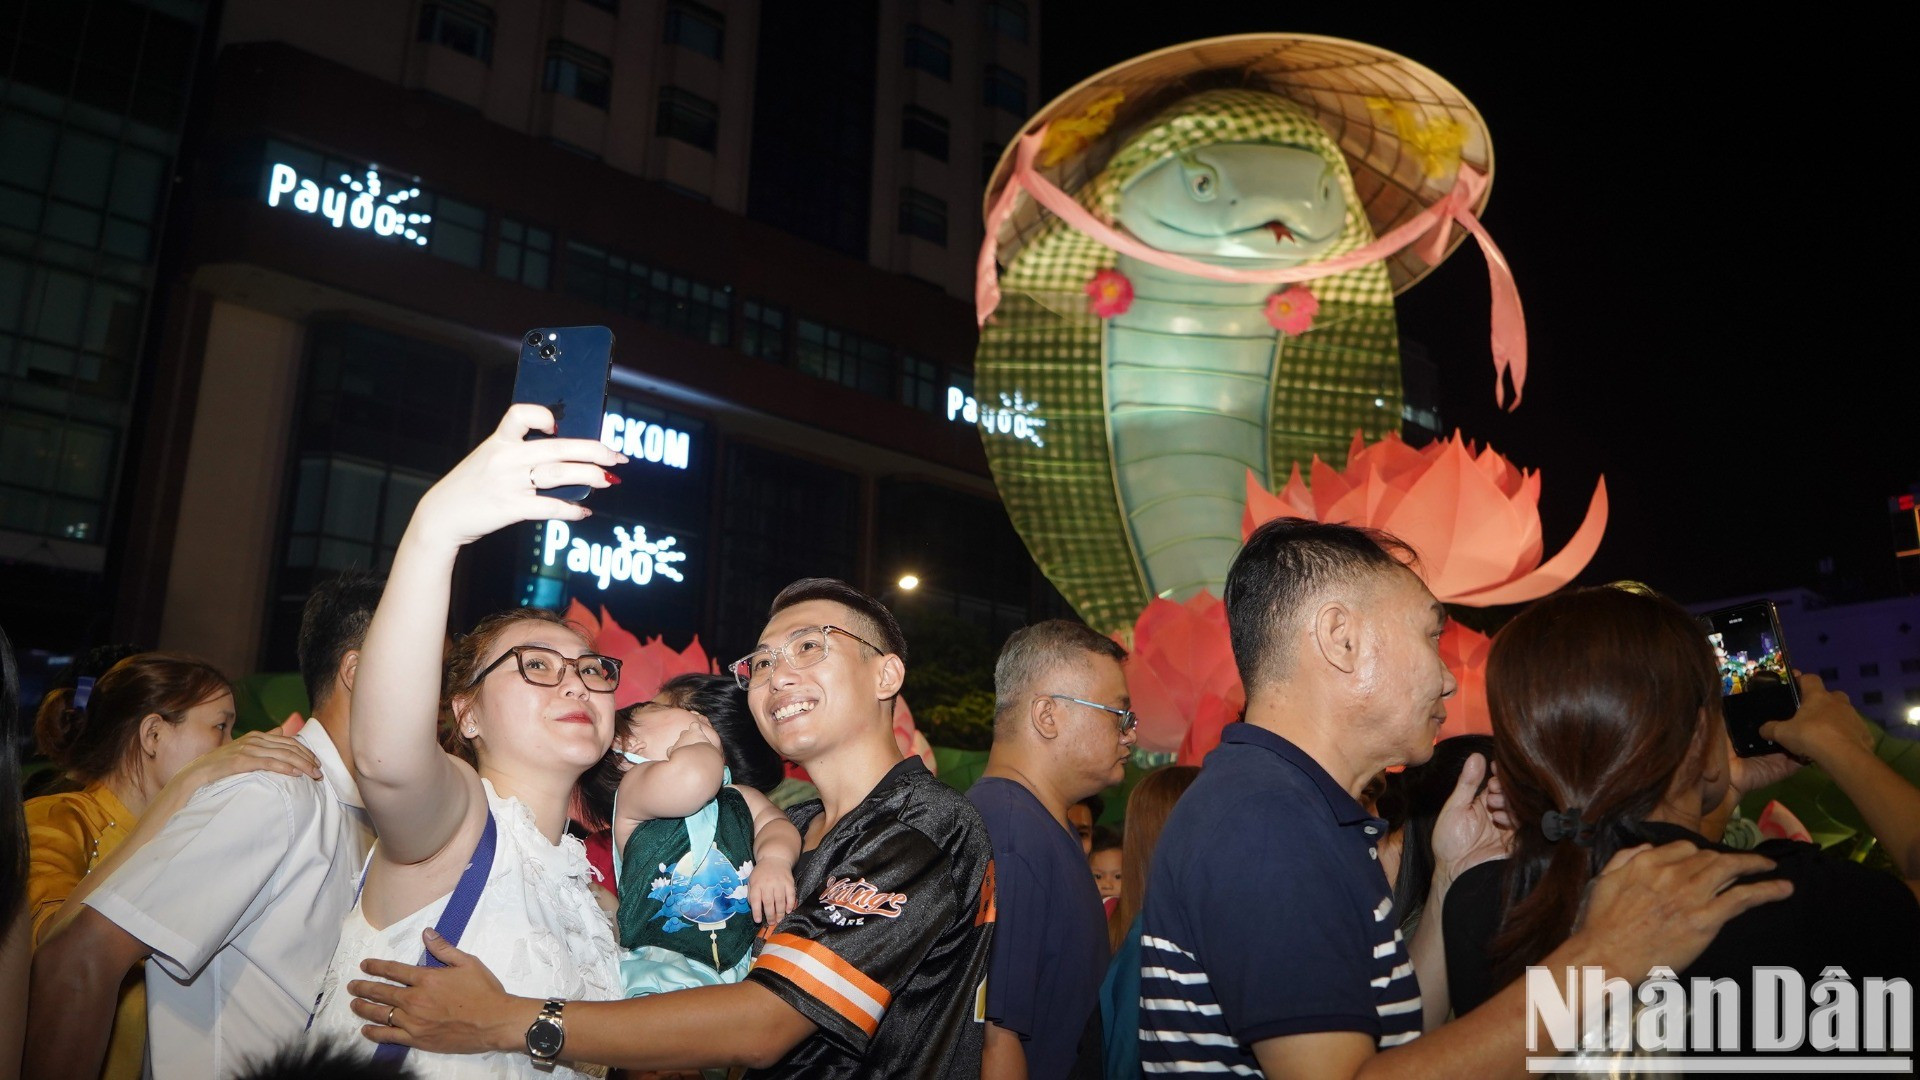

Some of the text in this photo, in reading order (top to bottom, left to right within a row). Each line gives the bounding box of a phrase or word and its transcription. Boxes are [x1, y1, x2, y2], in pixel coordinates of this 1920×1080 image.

[268, 163, 398, 237] Payoo
[601, 412, 690, 470] CKOM
[947, 386, 1028, 439] Payoo
[544, 519, 654, 590] Payoo
